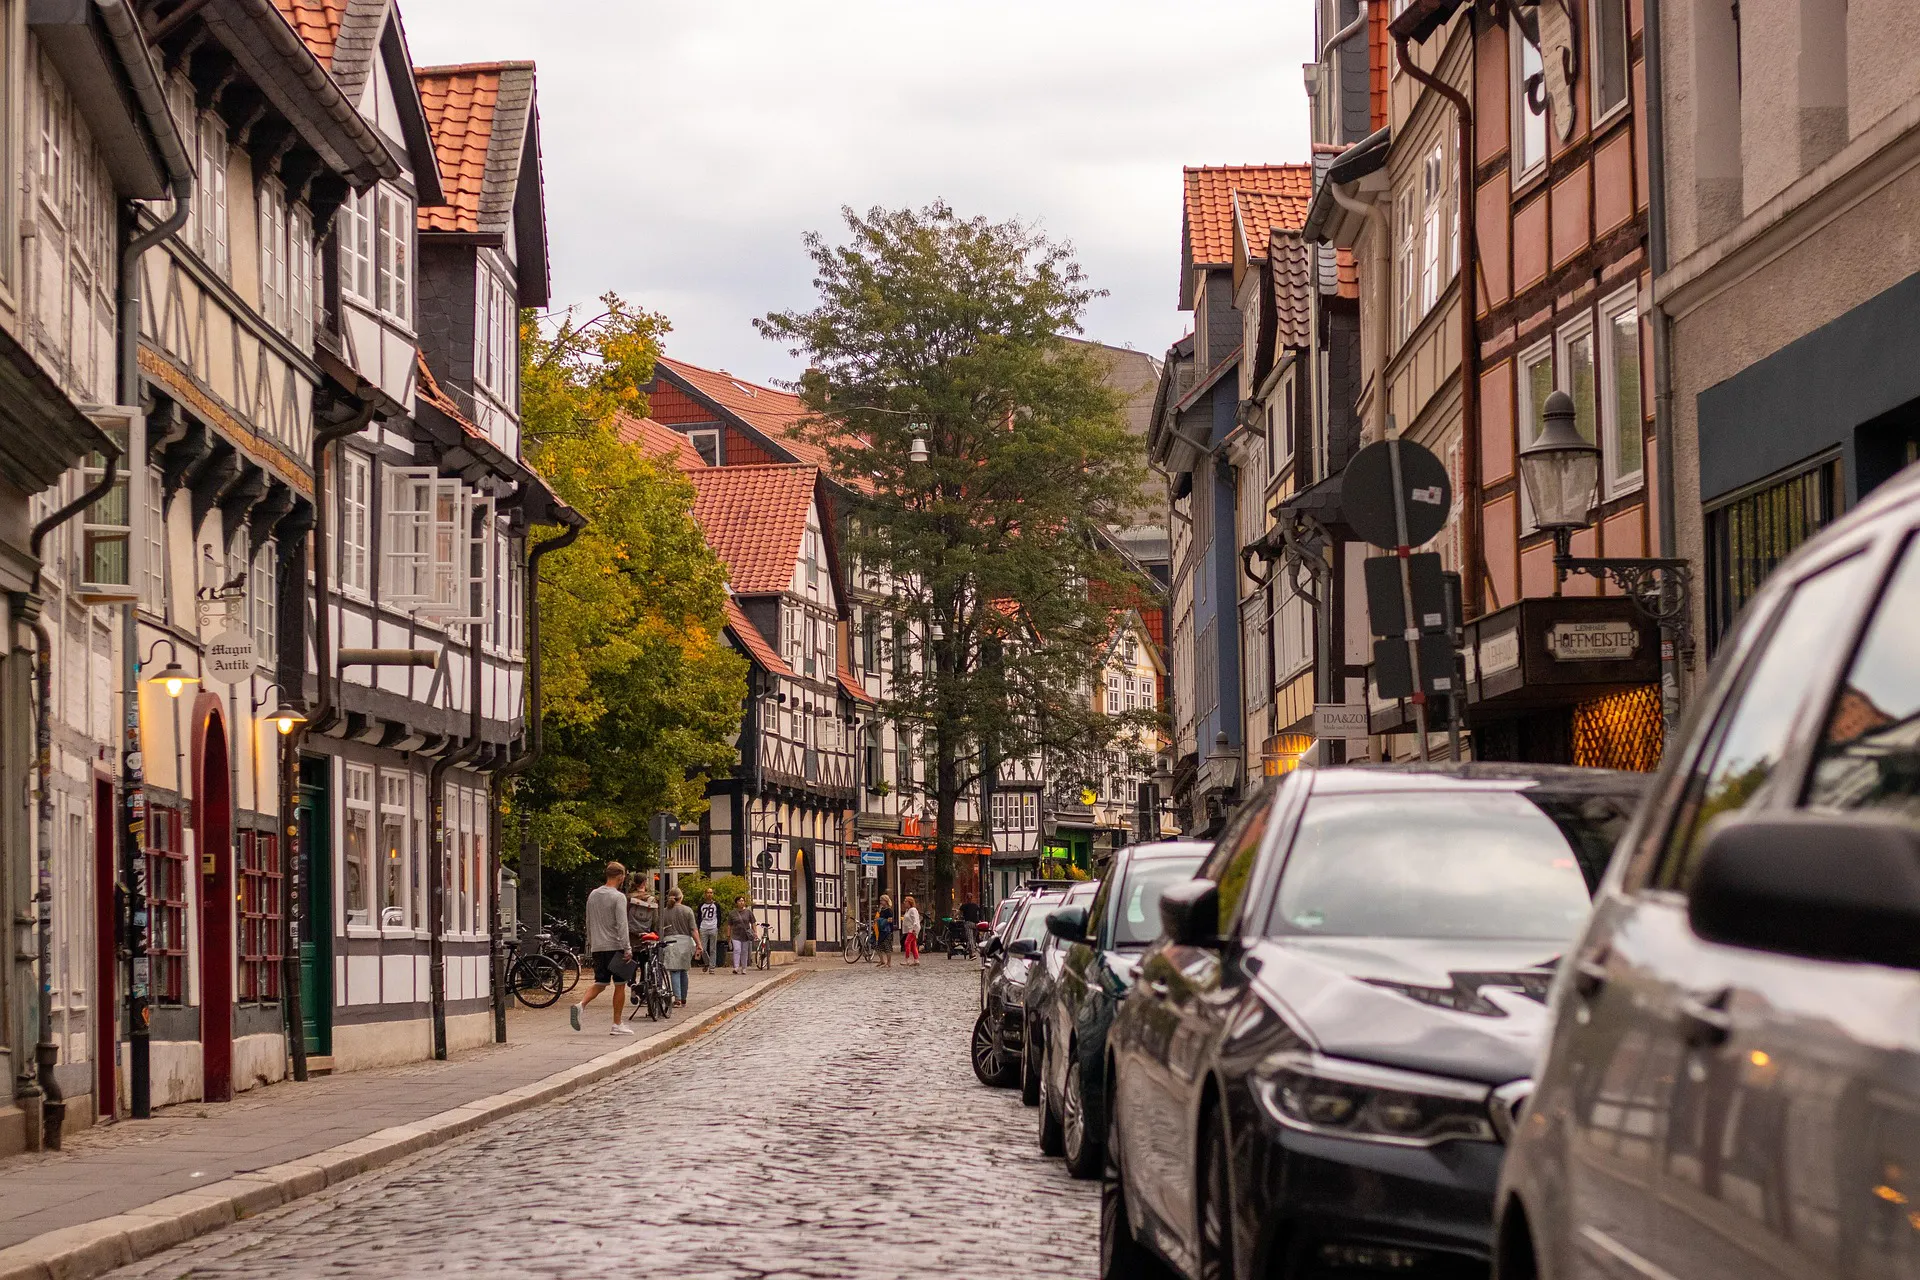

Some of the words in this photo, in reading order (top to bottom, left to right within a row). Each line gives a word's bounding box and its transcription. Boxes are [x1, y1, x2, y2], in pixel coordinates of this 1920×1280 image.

[1553, 632, 1636, 648] HOFFMEISTER
[211, 643, 252, 657] Magni
[214, 659, 249, 671] Antik
[702, 906, 715, 919] 78
